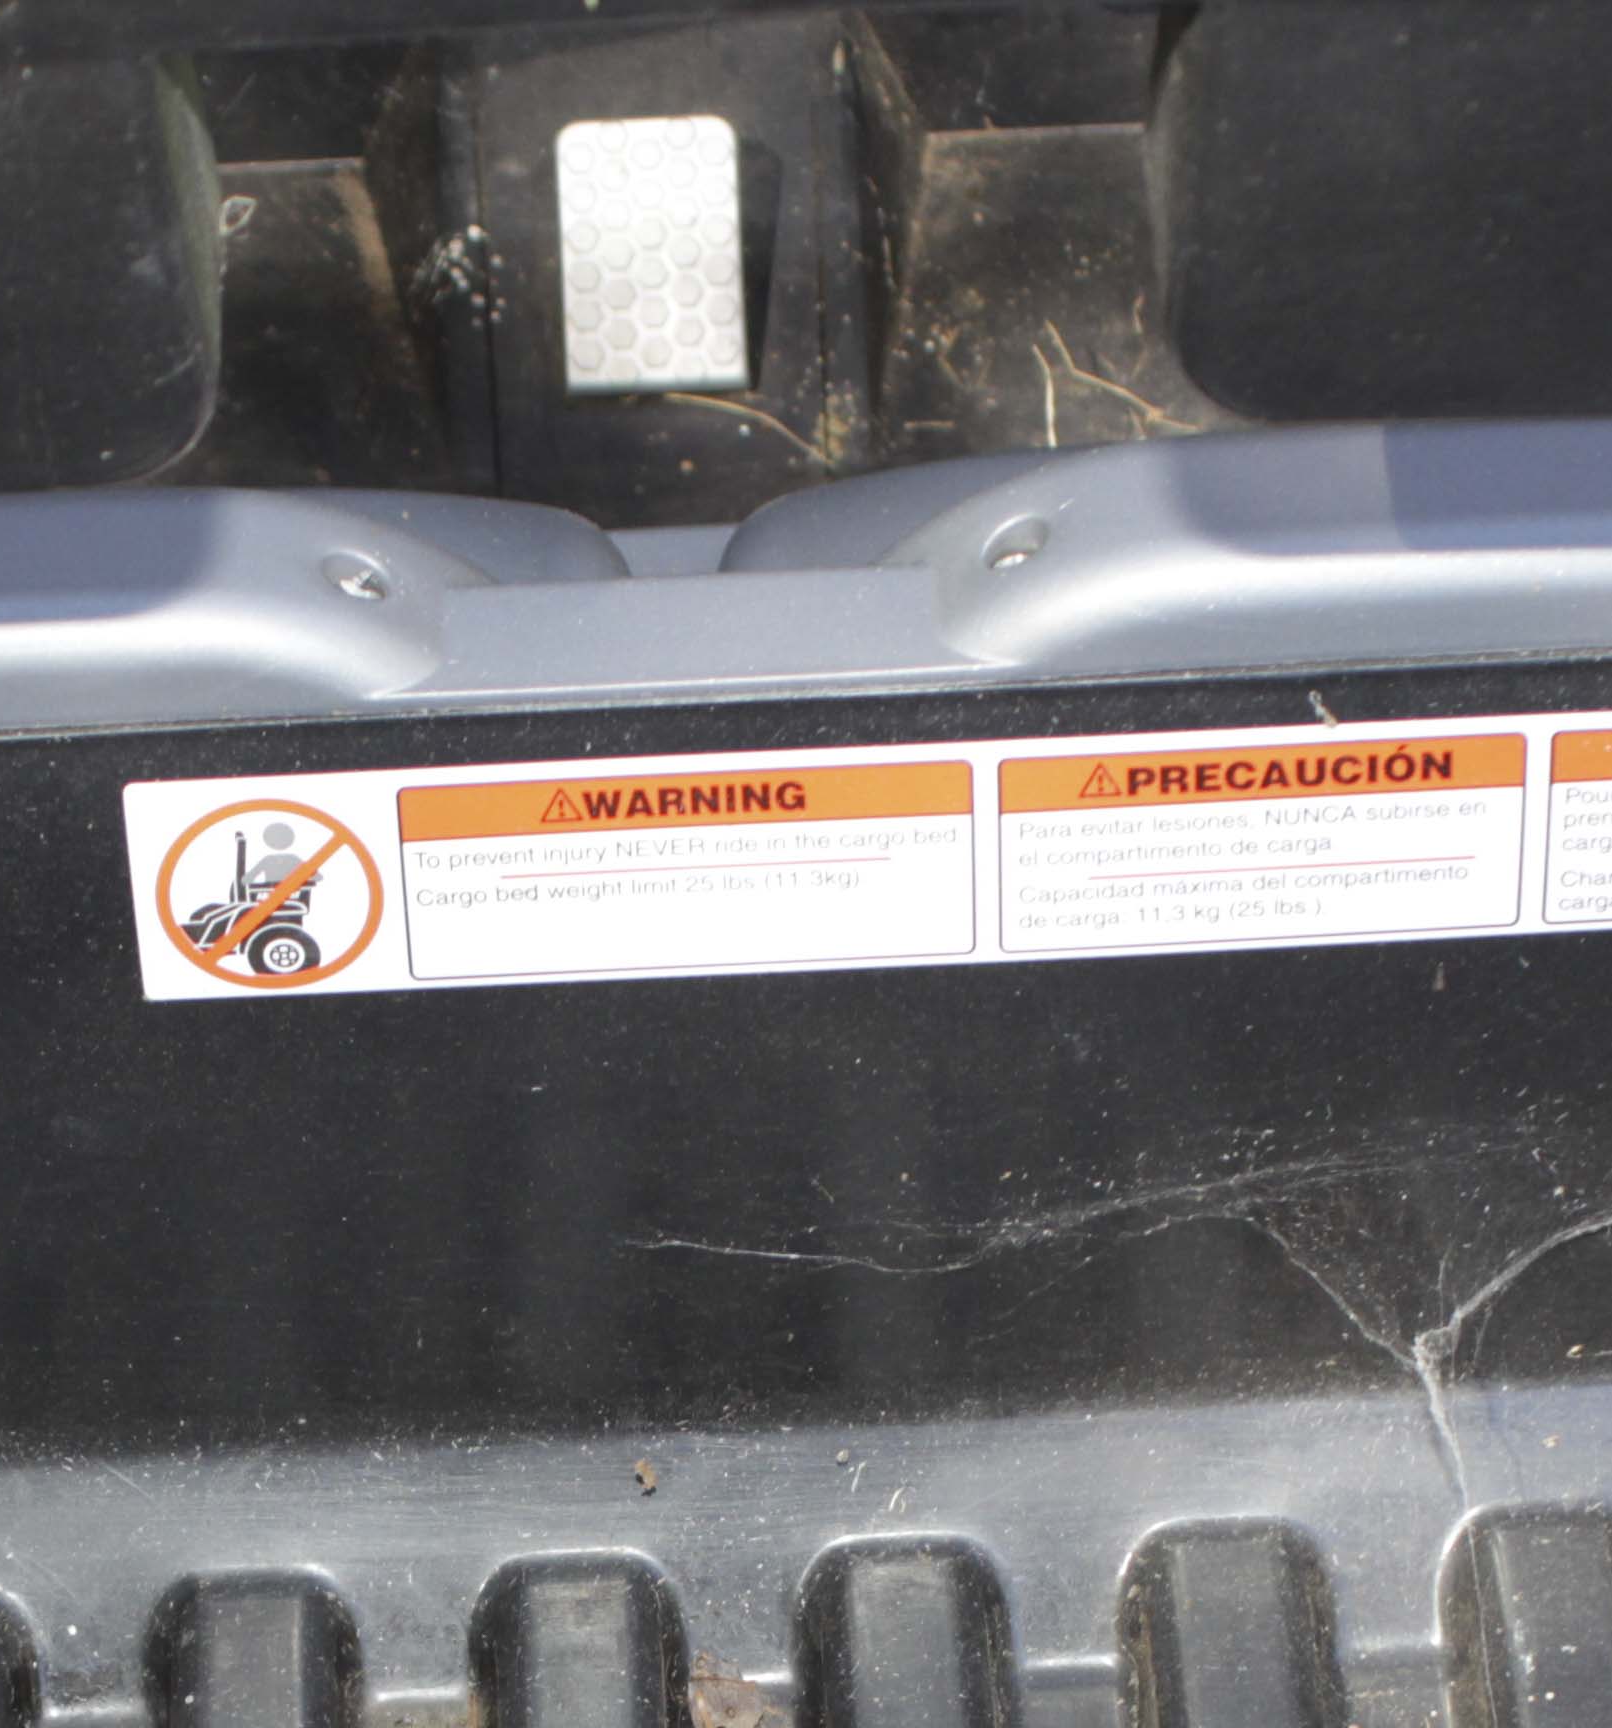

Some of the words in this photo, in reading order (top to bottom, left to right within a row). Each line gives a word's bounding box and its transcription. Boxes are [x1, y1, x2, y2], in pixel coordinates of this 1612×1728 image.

[1126, 744, 1453, 796] PRECAUCIÓN
[581, 782, 806, 819] WARNING
[1019, 821, 1071, 838] Para
[1080, 817, 1142, 835] evitar
[1264, 806, 1357, 825] NUNCA
[1366, 801, 1450, 819] subirse
[1458, 803, 1486, 814] en
[413, 851, 440, 867] To
[448, 847, 534, 868] prevent
[543, 843, 606, 864] injury
[616, 838, 705, 857] NEVER
[715, 836, 757, 852] ride
[767, 834, 785, 849] in
[795, 832, 830, 848] the
[839, 832, 905, 849] cargo
[913, 826, 958, 842] bed
[1019, 849, 1038, 864] el
[1046, 840, 1222, 866] compartimento
[1230, 838, 1258, 854] de
[1266, 839, 1332, 855] carga
[414, 887, 487, 909] Cargo
[495, 884, 538, 901] bed
[547, 880, 621, 901] weight
[631, 878, 675, 894] limit
[686, 876, 714, 892] 25
[723, 872, 755, 889] lbs
[764, 869, 861, 888] (113kg)
[1019, 881, 1144, 906] Capacidad
[1152, 875, 1243, 895] máxima
[1251, 873, 1286, 889] del
[1294, 865, 1469, 890] compartimento
[1019, 912, 1047, 928] de
[1194, 904, 1220, 923] kg
[1229, 901, 1265, 920] (25
